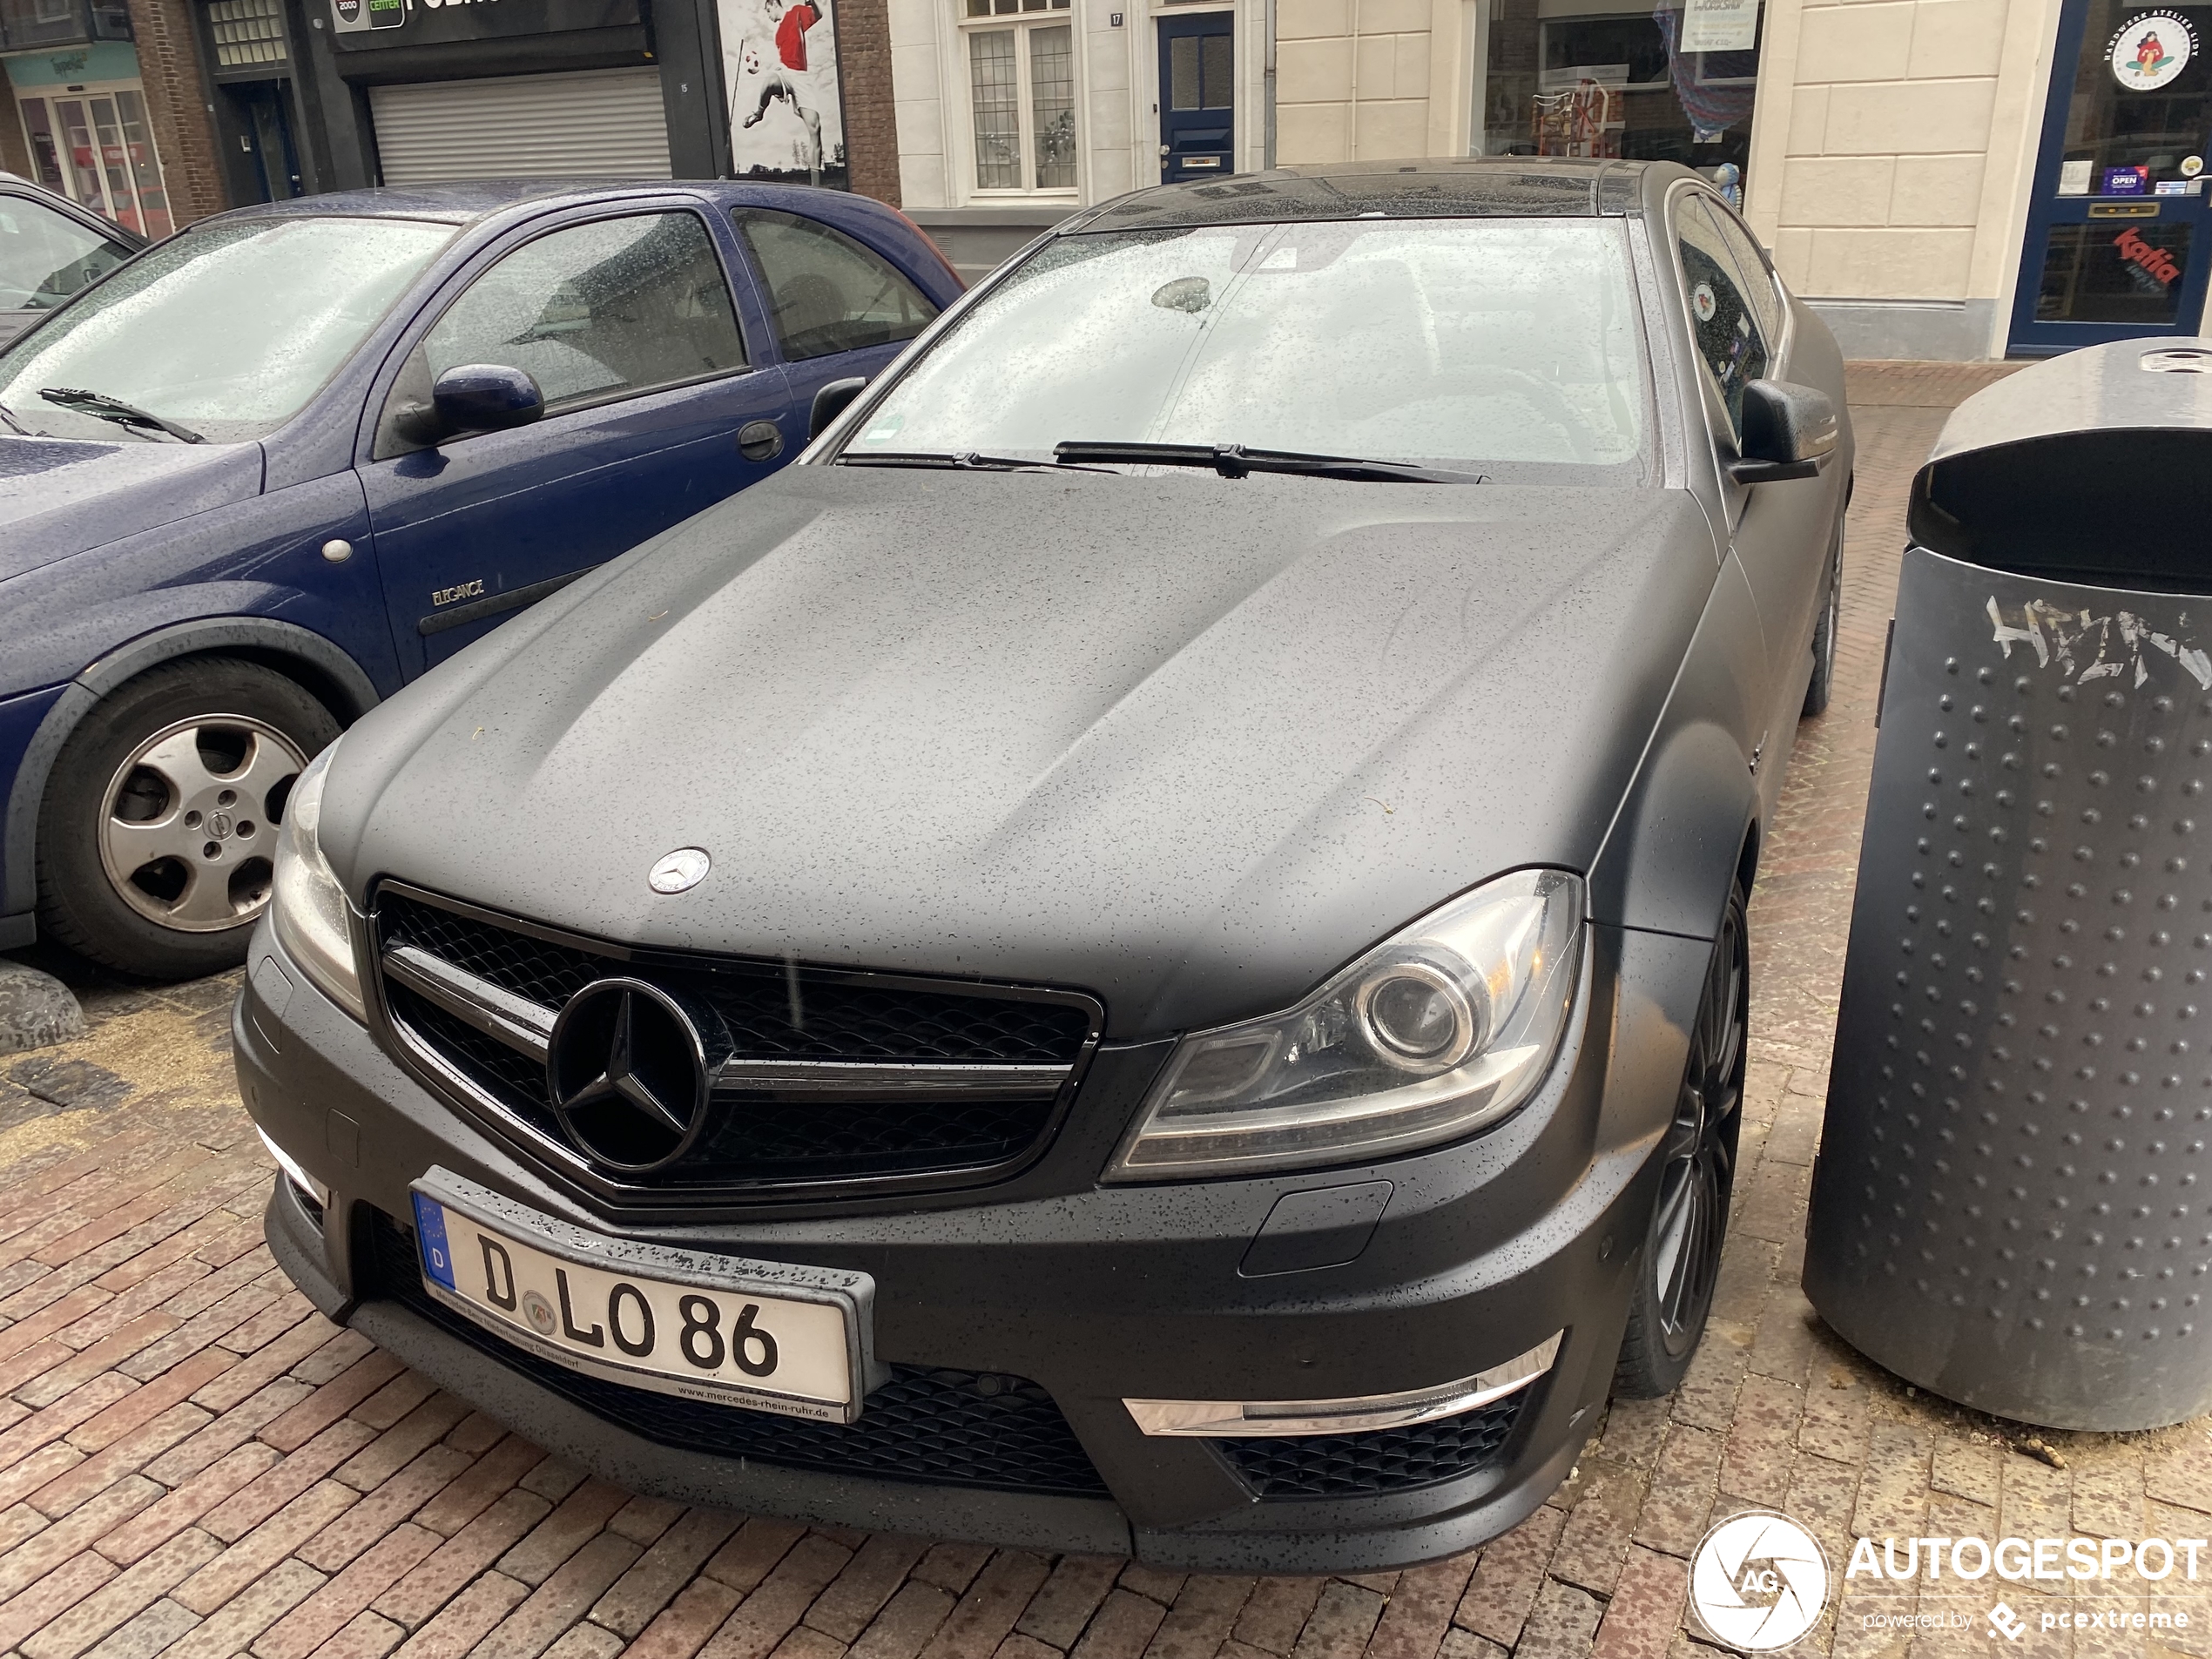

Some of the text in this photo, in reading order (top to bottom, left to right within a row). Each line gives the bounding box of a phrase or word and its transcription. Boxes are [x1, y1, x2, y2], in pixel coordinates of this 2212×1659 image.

[339, 0, 357, 10] 2000
[1112, 14, 1121, 25] 17
[2104, 10, 2200, 61] HANDWERK ATELIER LIDY
[681, 84, 688, 93] 15
[2112, 176, 2137, 185] OPEN
[431, 579, 484, 607] ELEGANCE
[432, 1246, 444, 1269] D
[477, 1233, 778, 1377] D LO 86
[678, 1386, 830, 1418] www.mercedes-rhein-ruhr.de
